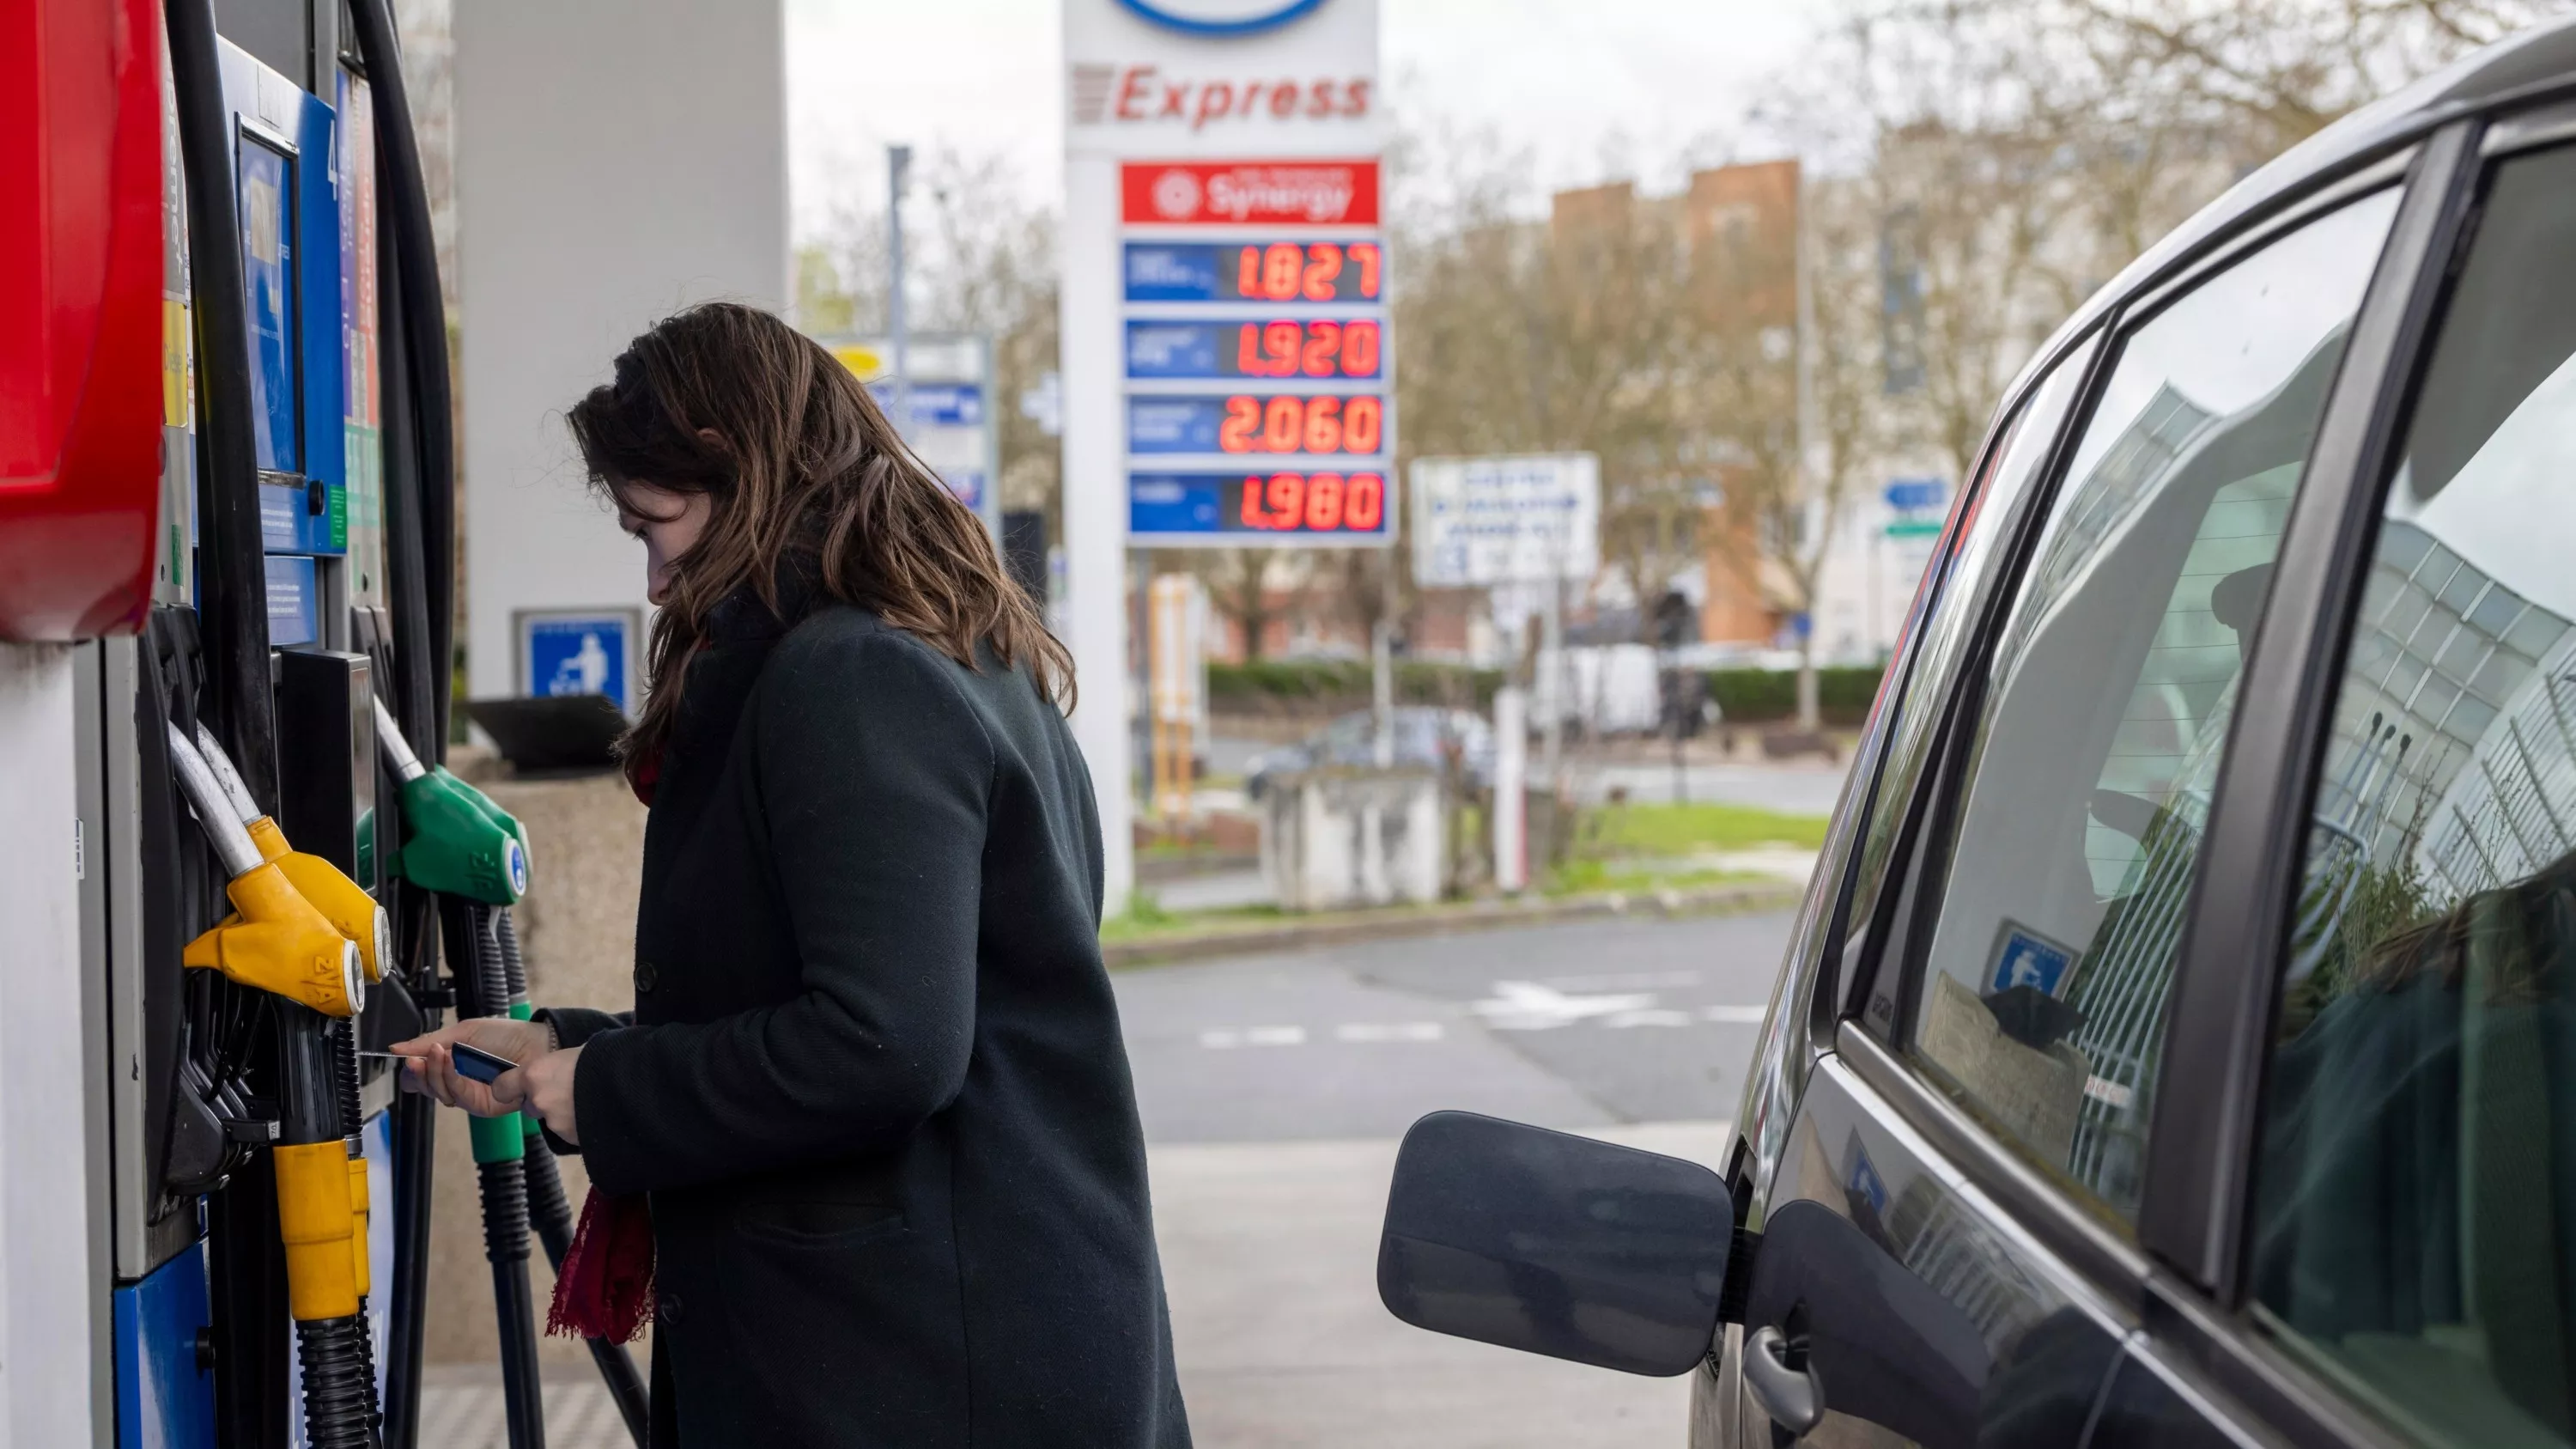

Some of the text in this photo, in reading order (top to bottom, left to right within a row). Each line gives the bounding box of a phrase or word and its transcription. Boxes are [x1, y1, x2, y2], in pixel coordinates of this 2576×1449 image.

[1115, 64, 1372, 131] Express
[328, 119, 337, 201] 4
[1206, 174, 1354, 222] Synergy
